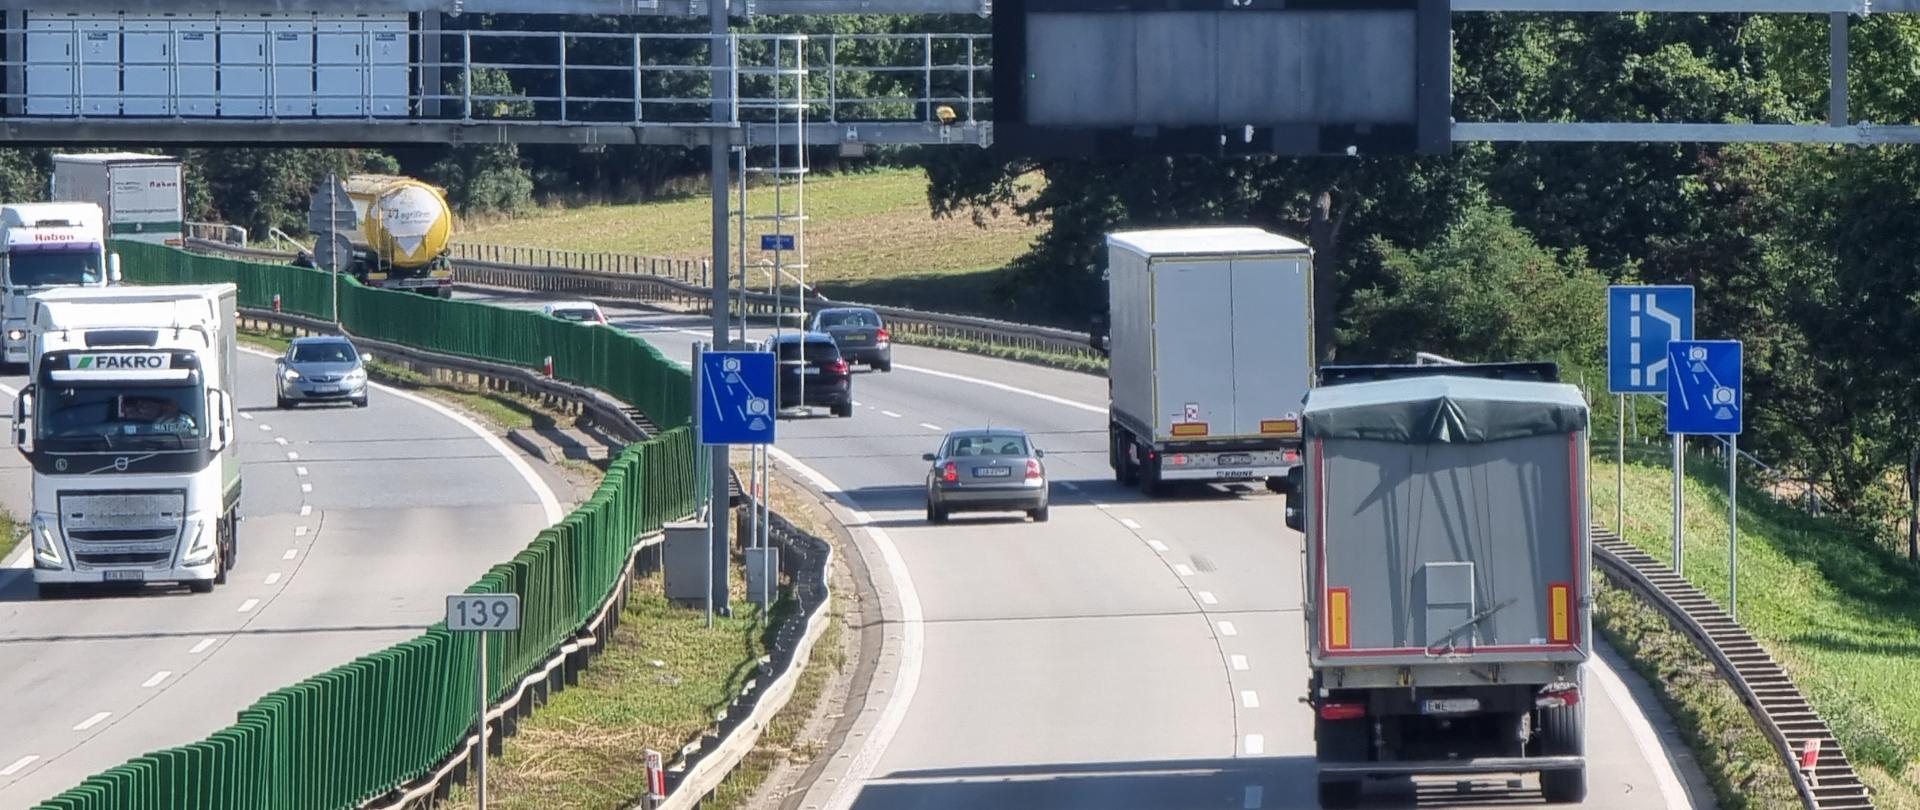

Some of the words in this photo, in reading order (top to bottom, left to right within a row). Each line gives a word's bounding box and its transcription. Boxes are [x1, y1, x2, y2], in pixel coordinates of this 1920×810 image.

[35, 234, 74, 242] Raben
[96, 356, 162, 368] FAKRO
[457, 600, 509, 627] 139
